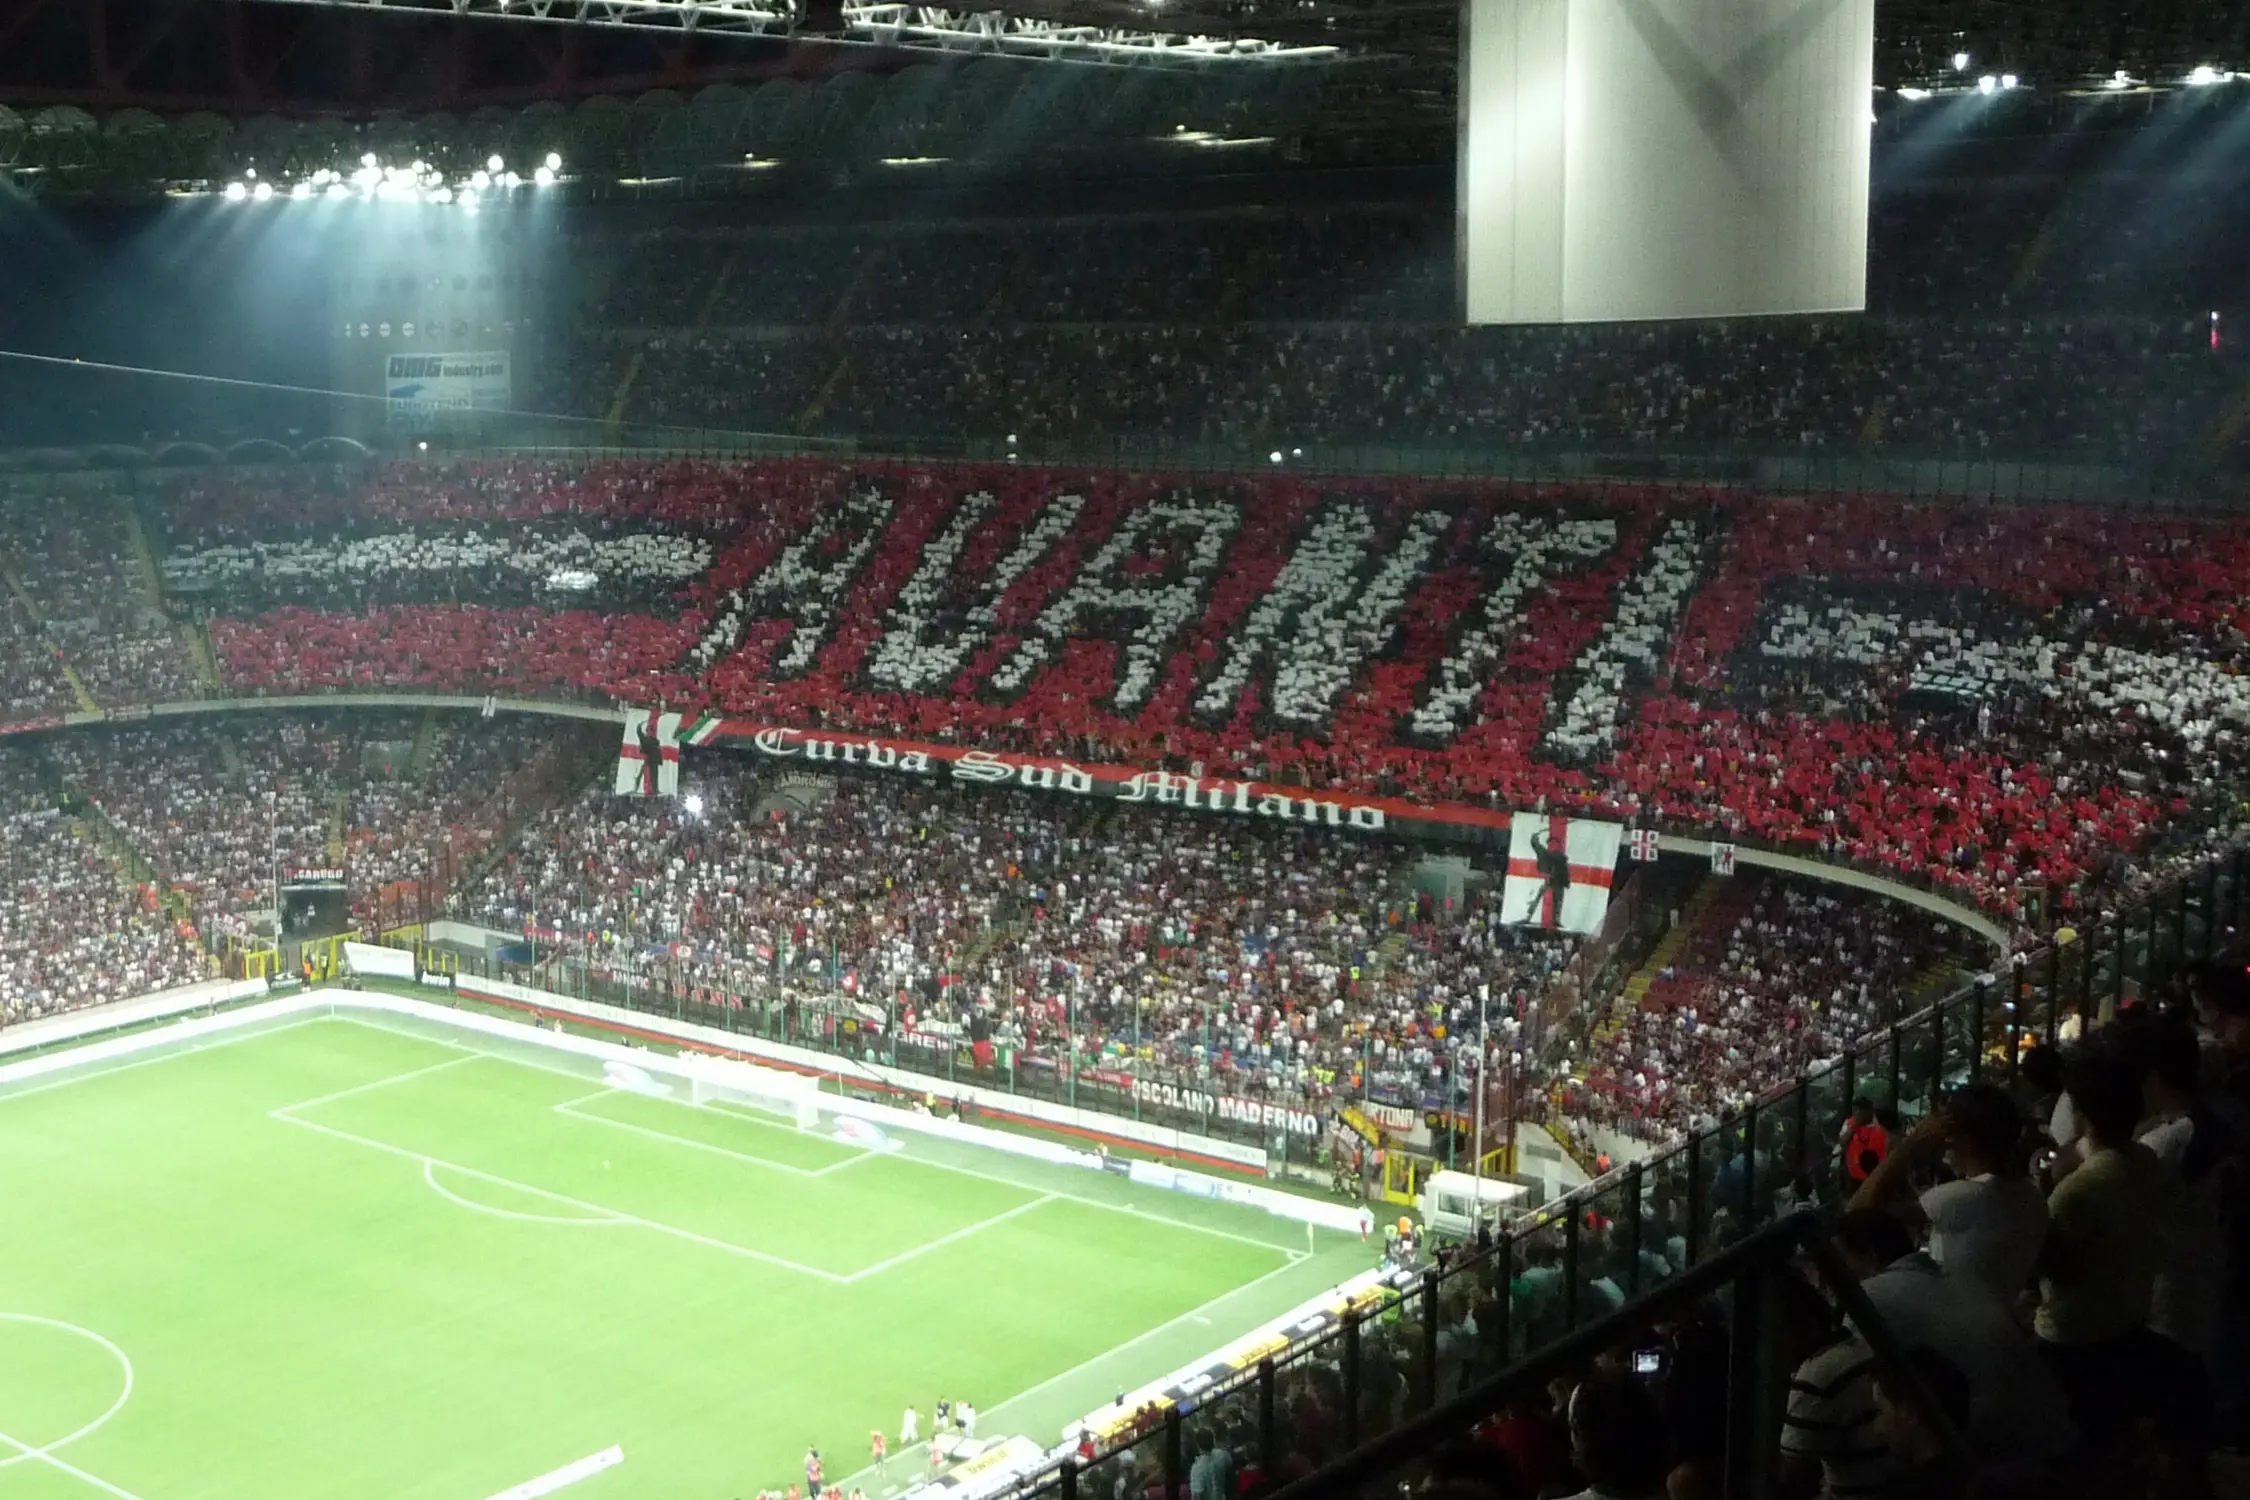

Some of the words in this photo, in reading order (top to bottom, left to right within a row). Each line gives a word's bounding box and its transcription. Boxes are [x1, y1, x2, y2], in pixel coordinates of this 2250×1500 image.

[754, 727, 933, 772] Curva
[951, 749, 1093, 793] Sud
[1115, 770, 1385, 830] Milano
[1217, 1096, 1318, 1136] MADERNO
